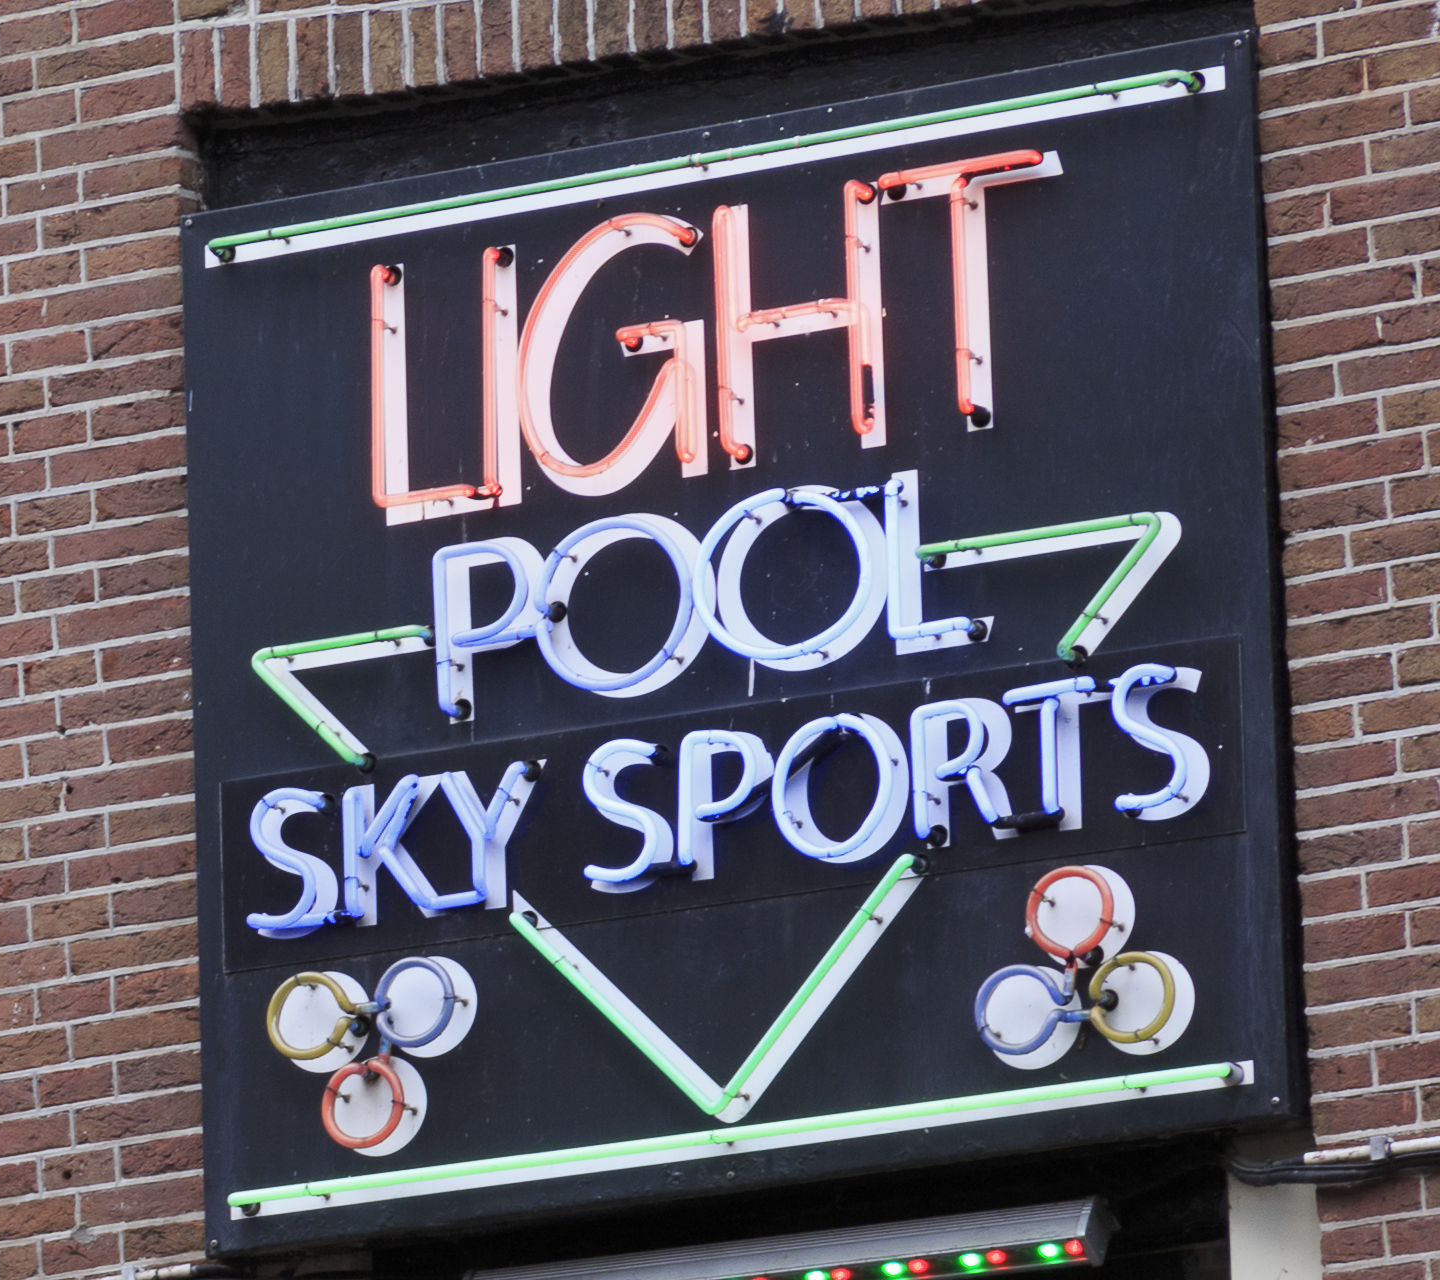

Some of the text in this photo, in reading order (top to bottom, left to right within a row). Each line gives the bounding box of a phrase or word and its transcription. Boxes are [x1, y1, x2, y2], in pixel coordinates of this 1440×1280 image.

[370, 150, 1063, 526] LIGHT
[431, 472, 996, 724] POOL
[246, 662, 1211, 939] SKY SPORTS
